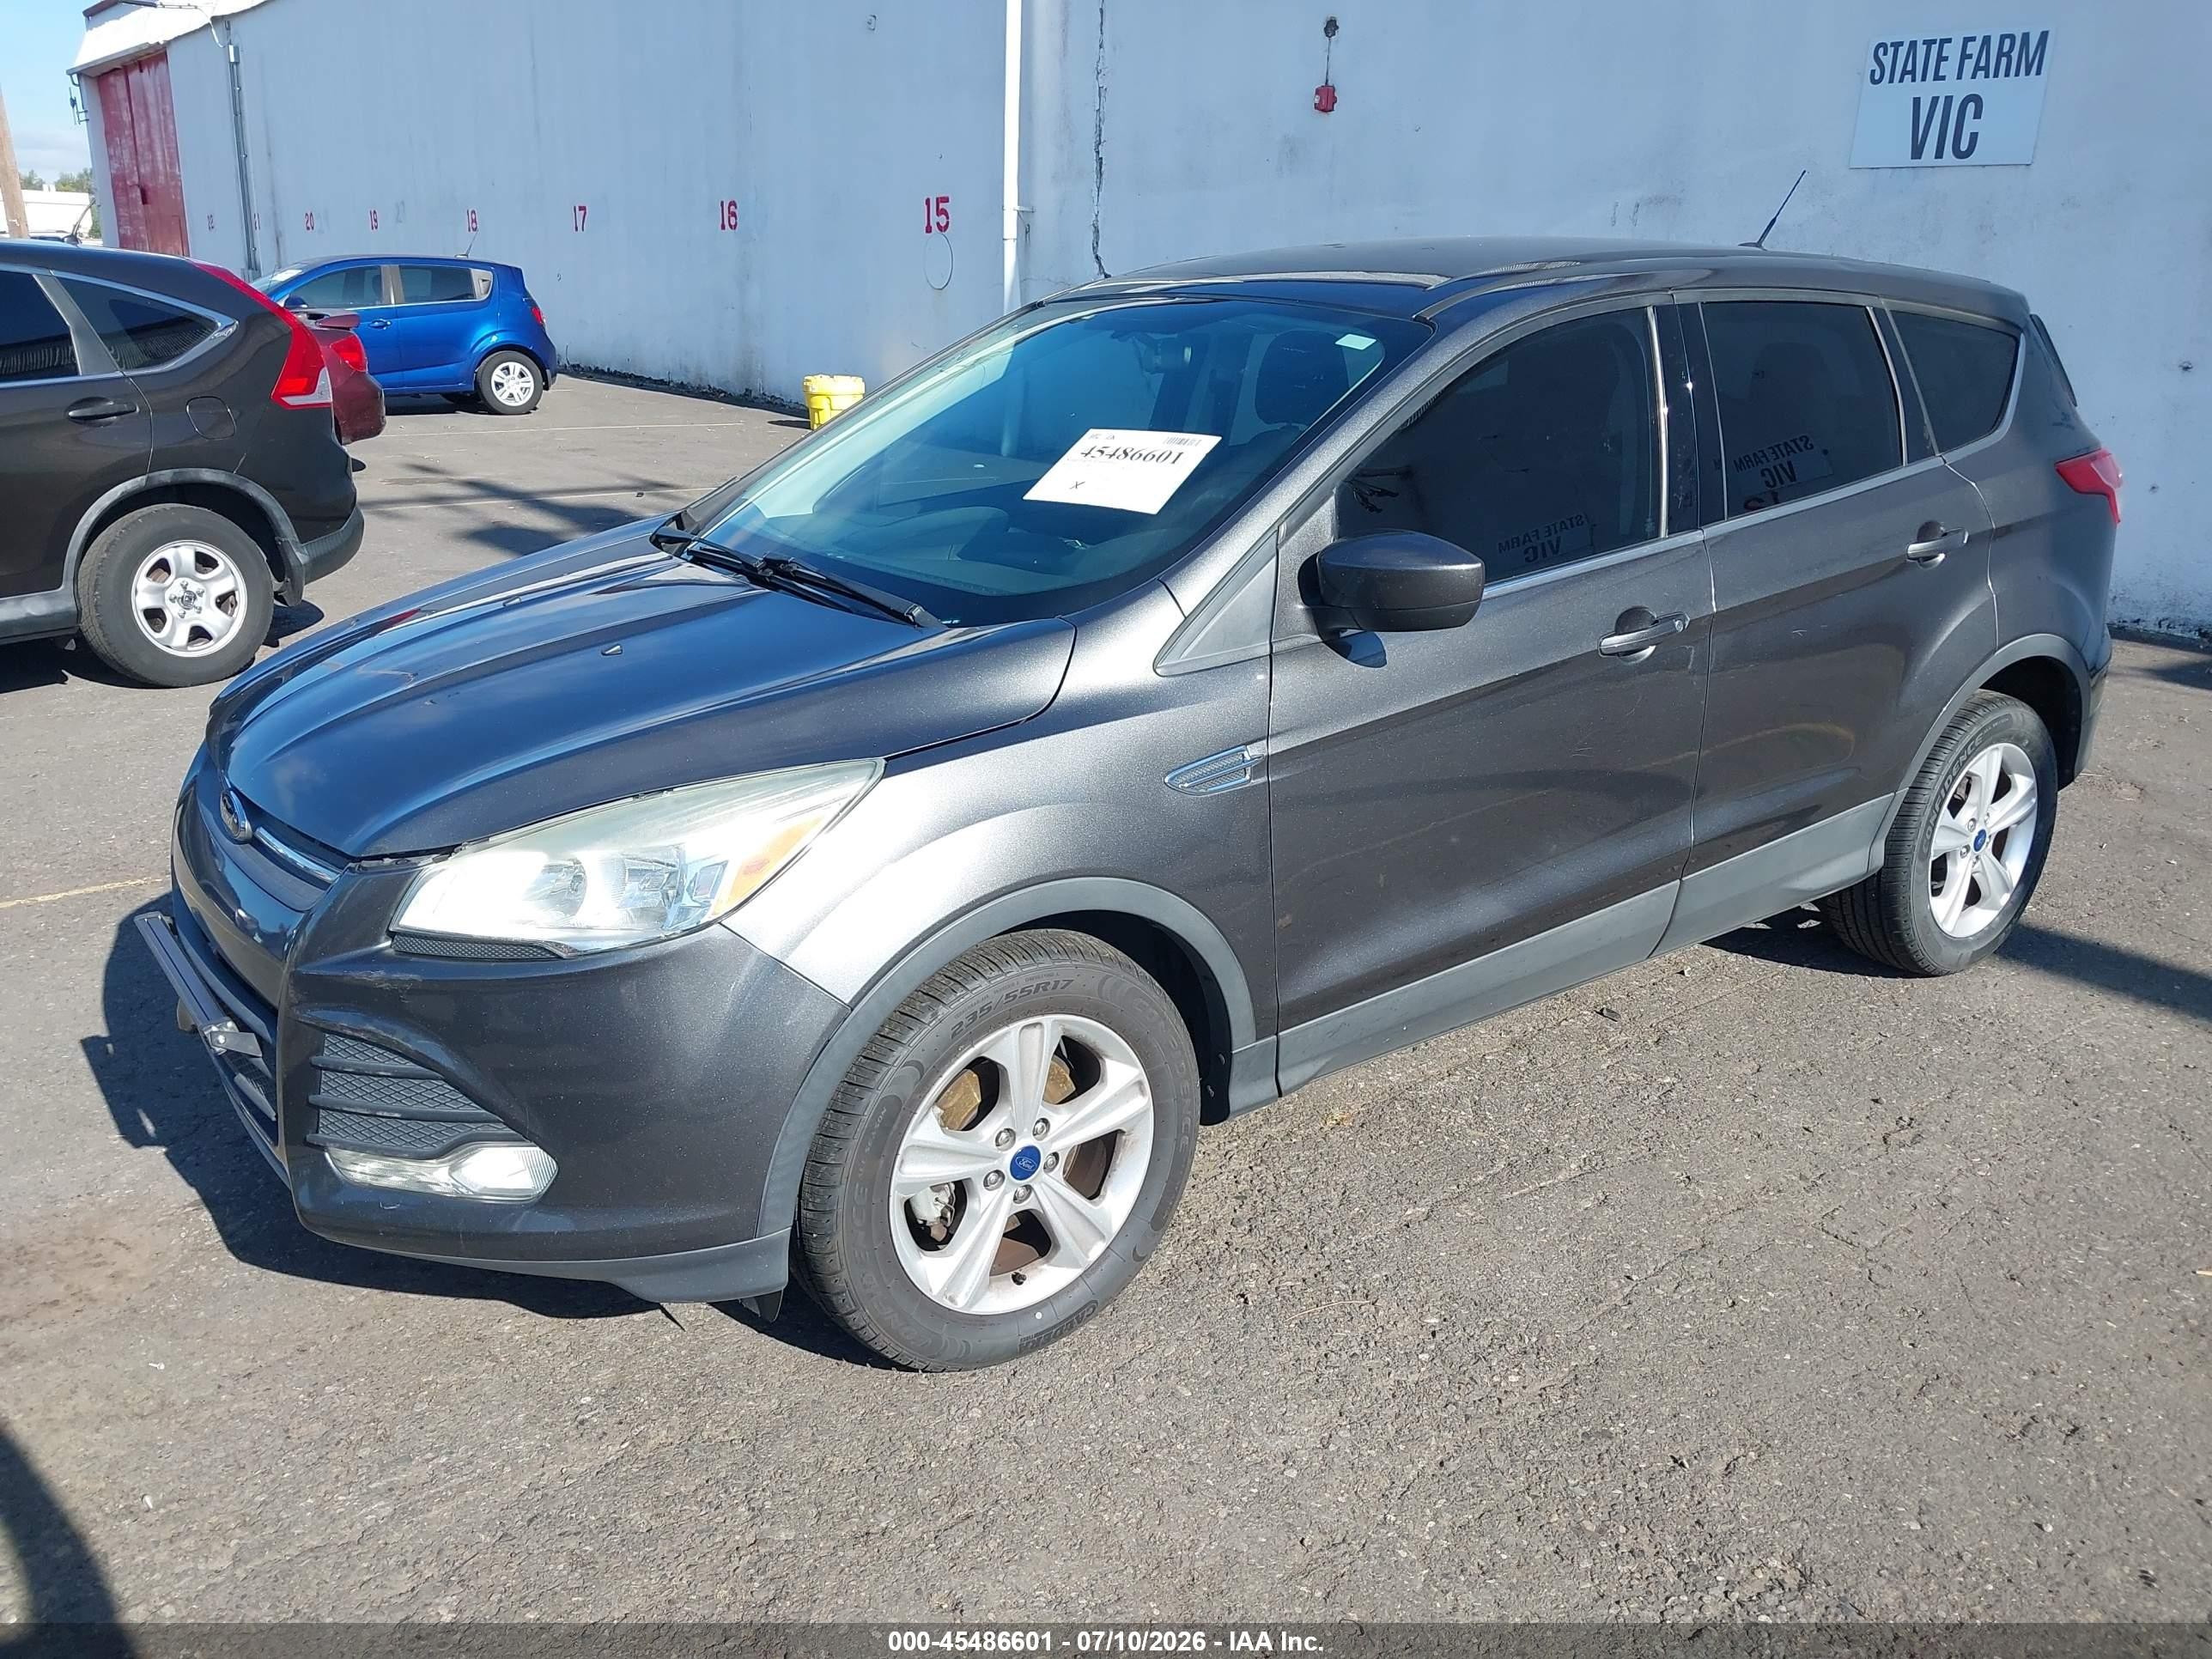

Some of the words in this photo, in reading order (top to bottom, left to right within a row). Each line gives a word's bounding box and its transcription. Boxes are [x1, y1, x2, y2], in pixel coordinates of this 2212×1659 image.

[1869, 37, 1953, 85] STATE
[1955, 30, 2050, 80] FARM
[1910, 94, 1984, 161] VIC
[304, 211, 315, 231] 20
[369, 209, 379, 231] 19
[466, 209, 478, 233] 18
[573, 205, 587, 233] 17
[720, 199, 738, 231] 16
[924, 196, 950, 234] 15
[1080, 444, 1185, 465] 45486601
[951, 979, 1074, 1040] 235/55R17
